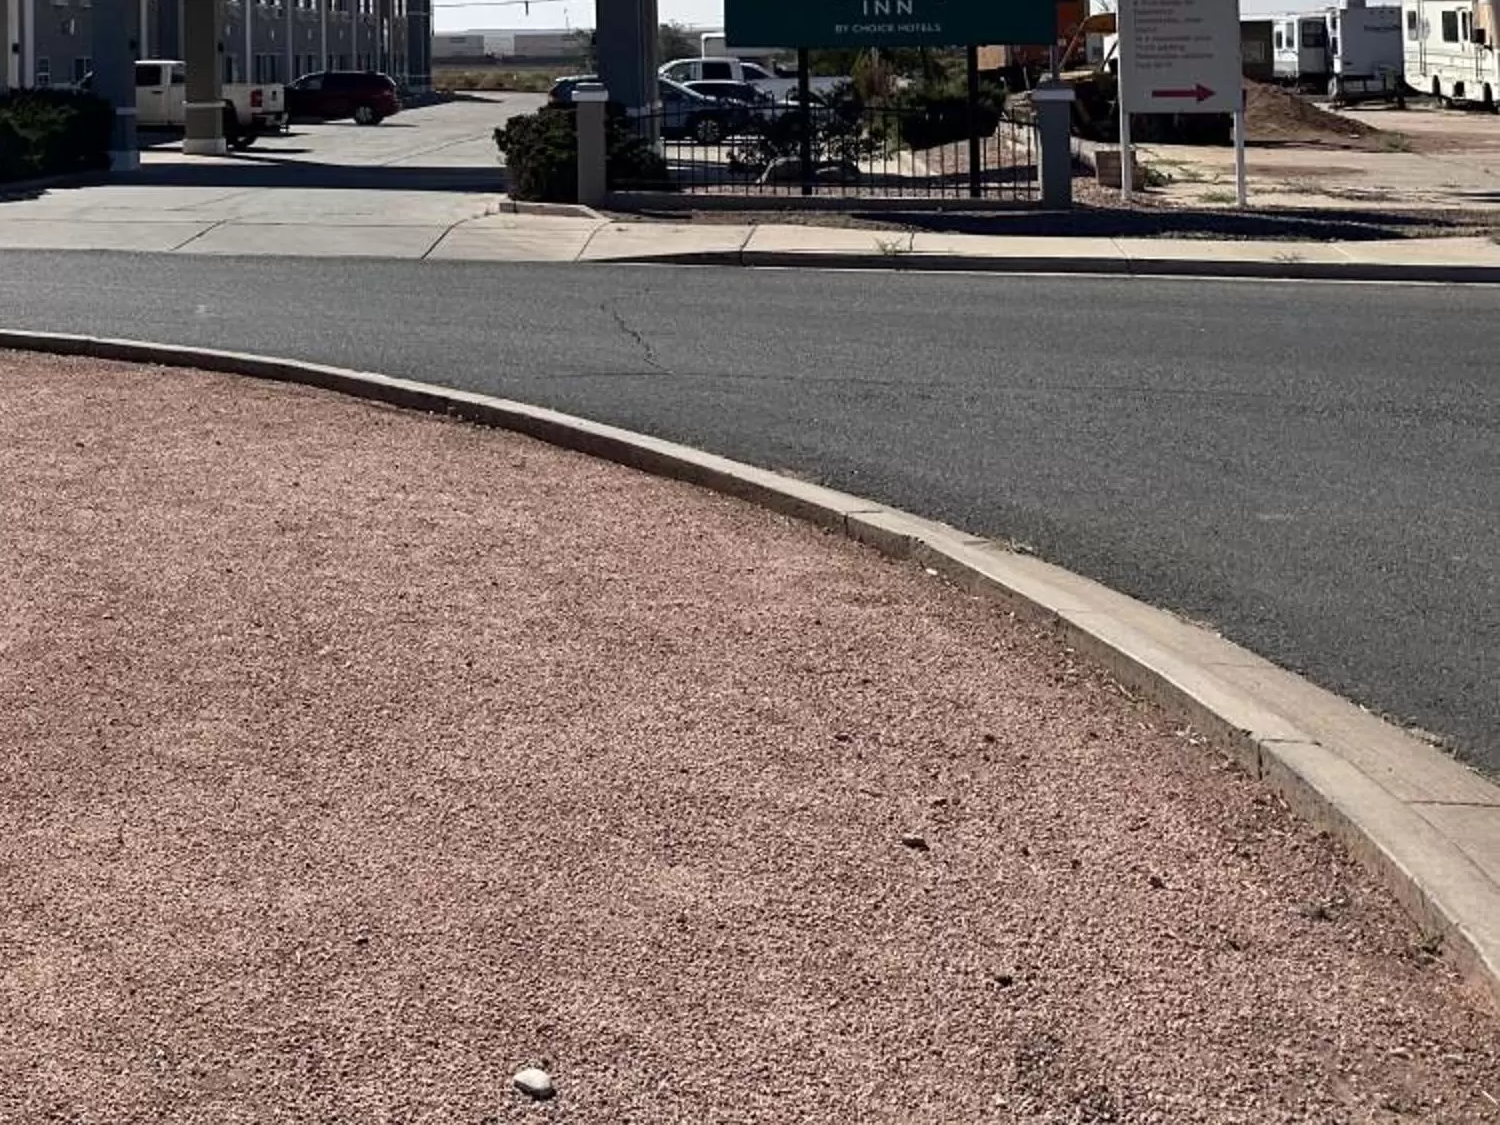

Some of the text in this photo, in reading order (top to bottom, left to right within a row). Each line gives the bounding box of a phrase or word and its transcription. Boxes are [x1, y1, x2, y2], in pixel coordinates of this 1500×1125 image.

[835, 22, 942, 34] BY CHOICE HOTELS
